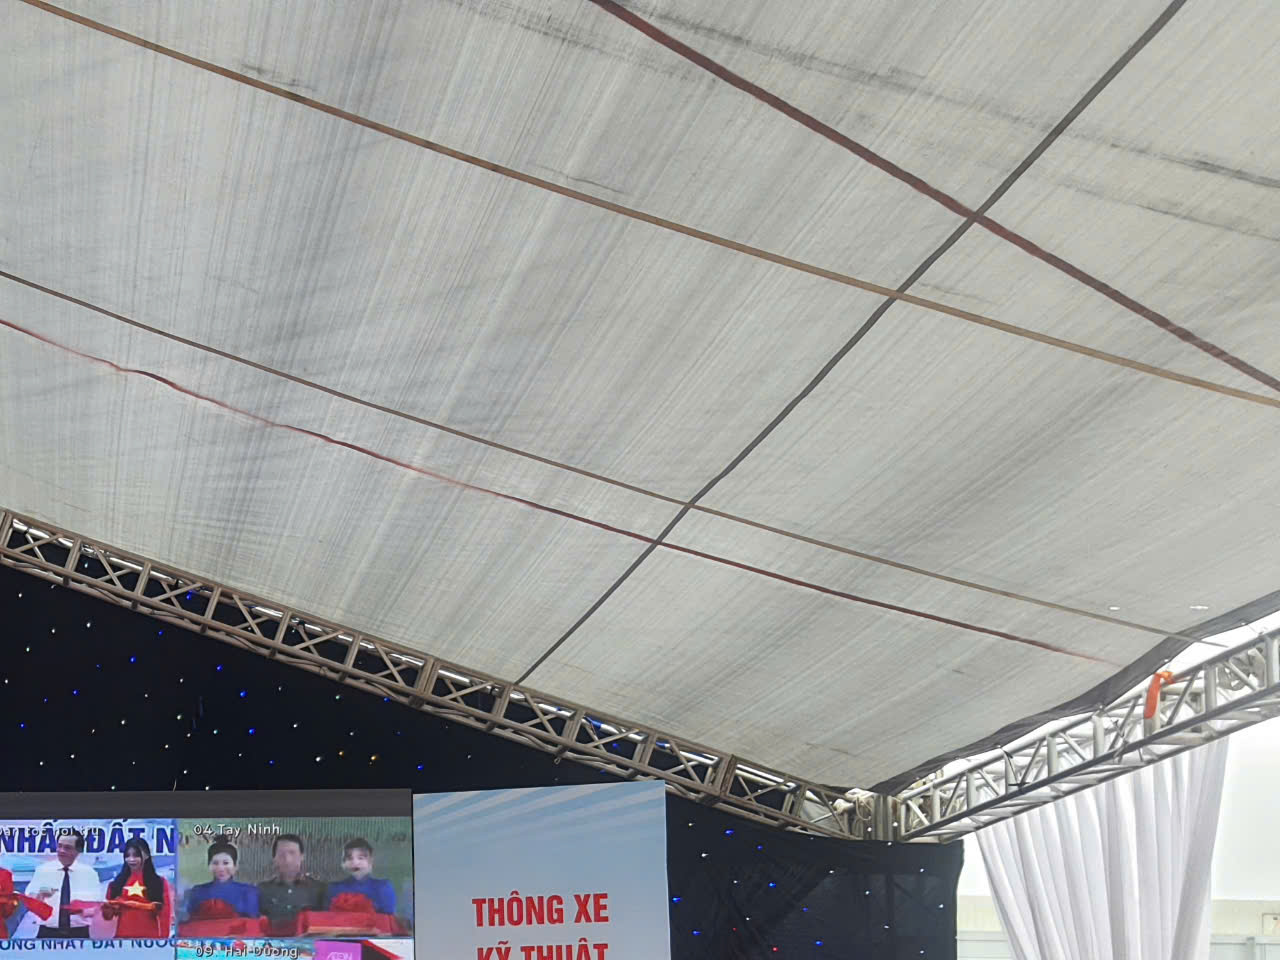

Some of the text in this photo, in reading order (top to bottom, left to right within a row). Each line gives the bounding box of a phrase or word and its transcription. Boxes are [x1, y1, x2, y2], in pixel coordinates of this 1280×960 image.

[248, 824, 280, 835] Ninh
[472, 891, 609, 927] THÔNG XE
